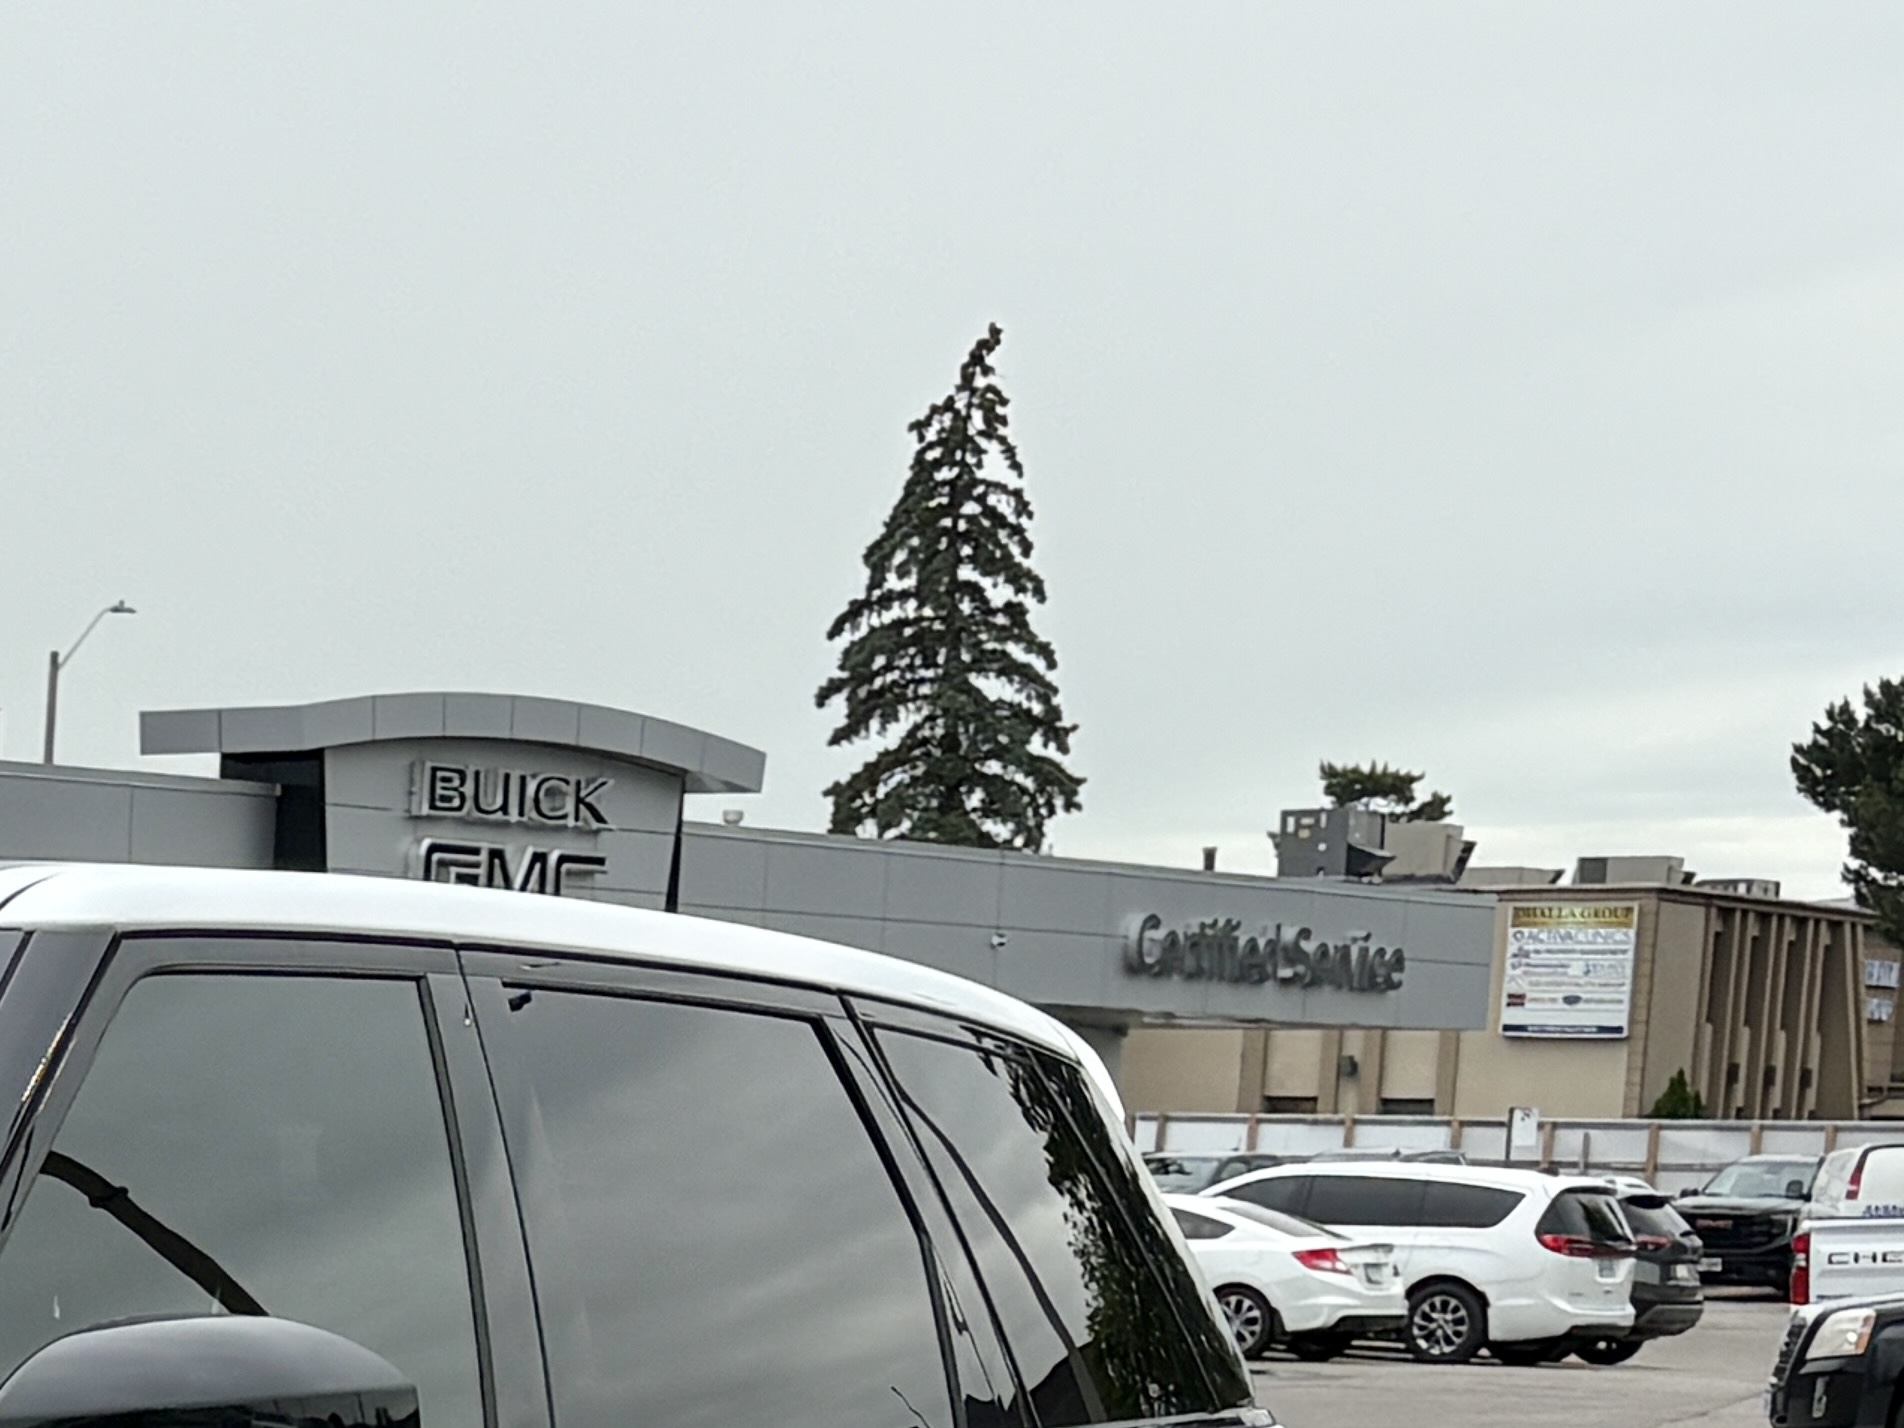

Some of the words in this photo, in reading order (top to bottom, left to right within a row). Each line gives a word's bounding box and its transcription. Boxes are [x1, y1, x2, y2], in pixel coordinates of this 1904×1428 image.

[422, 761, 614, 829] BUICK
[1130, 913, 1282, 984] Certified
[1280, 926, 1406, 992] Service
